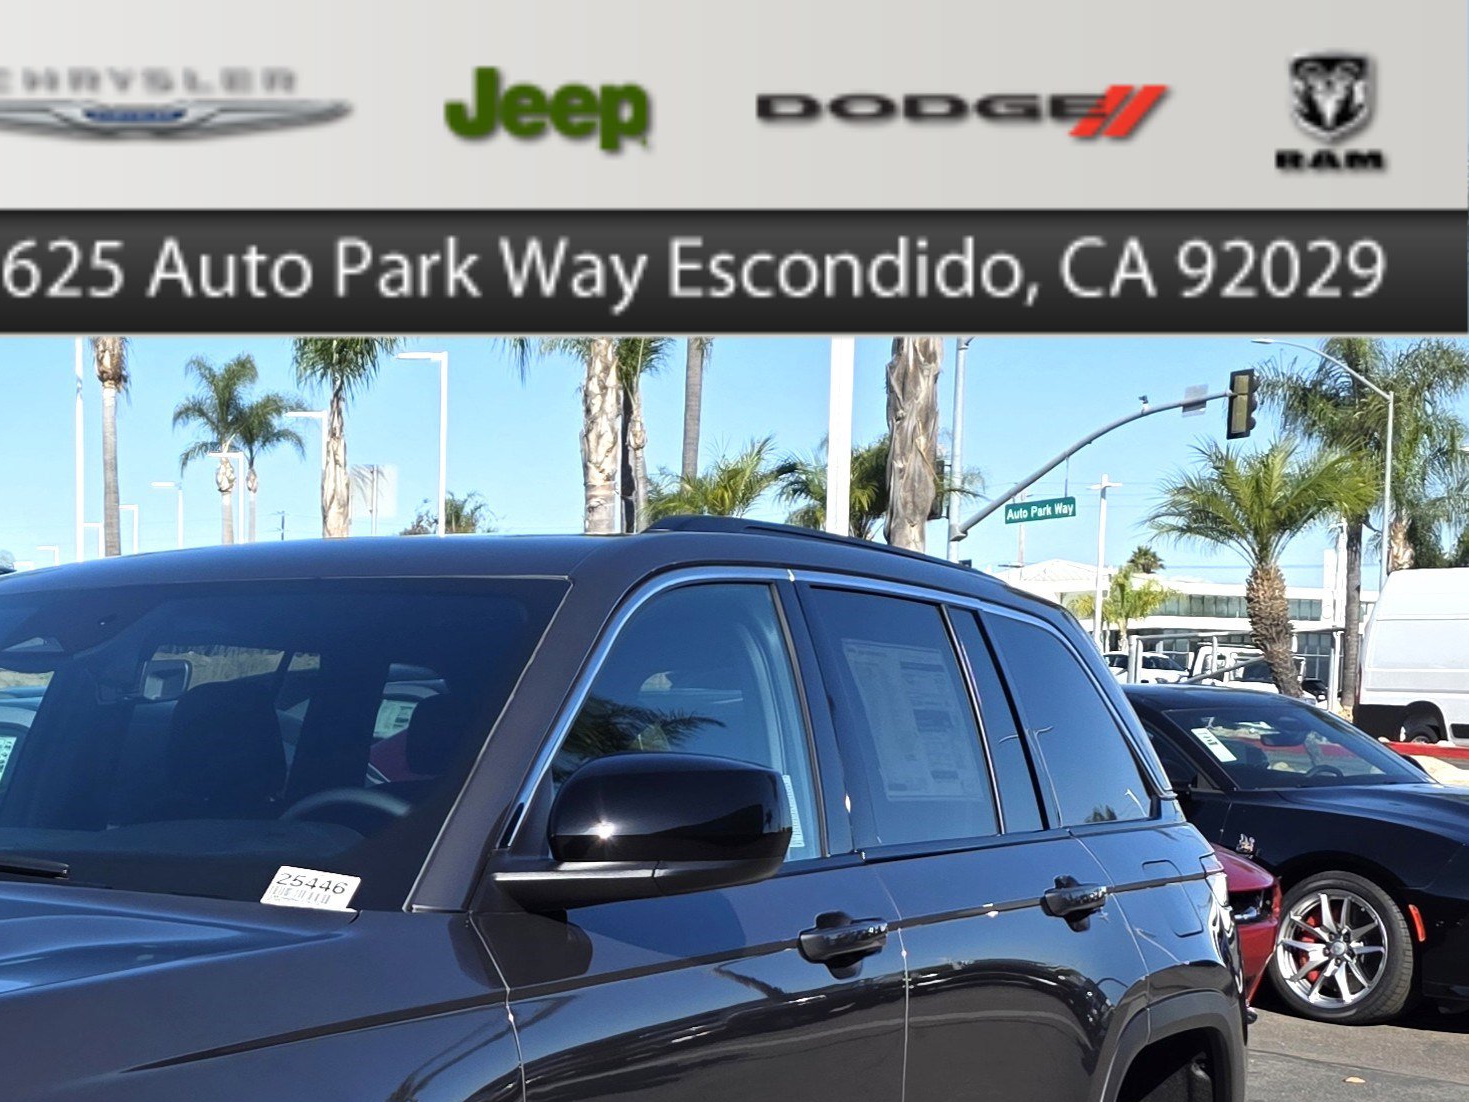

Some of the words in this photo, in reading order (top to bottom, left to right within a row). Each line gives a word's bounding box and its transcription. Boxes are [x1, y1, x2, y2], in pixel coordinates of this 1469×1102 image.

[1006, 508, 1029, 520] Auto
[1030, 504, 1052, 518] Park
[1054, 501, 1074, 516] Way
[276, 872, 348, 894] 25446
